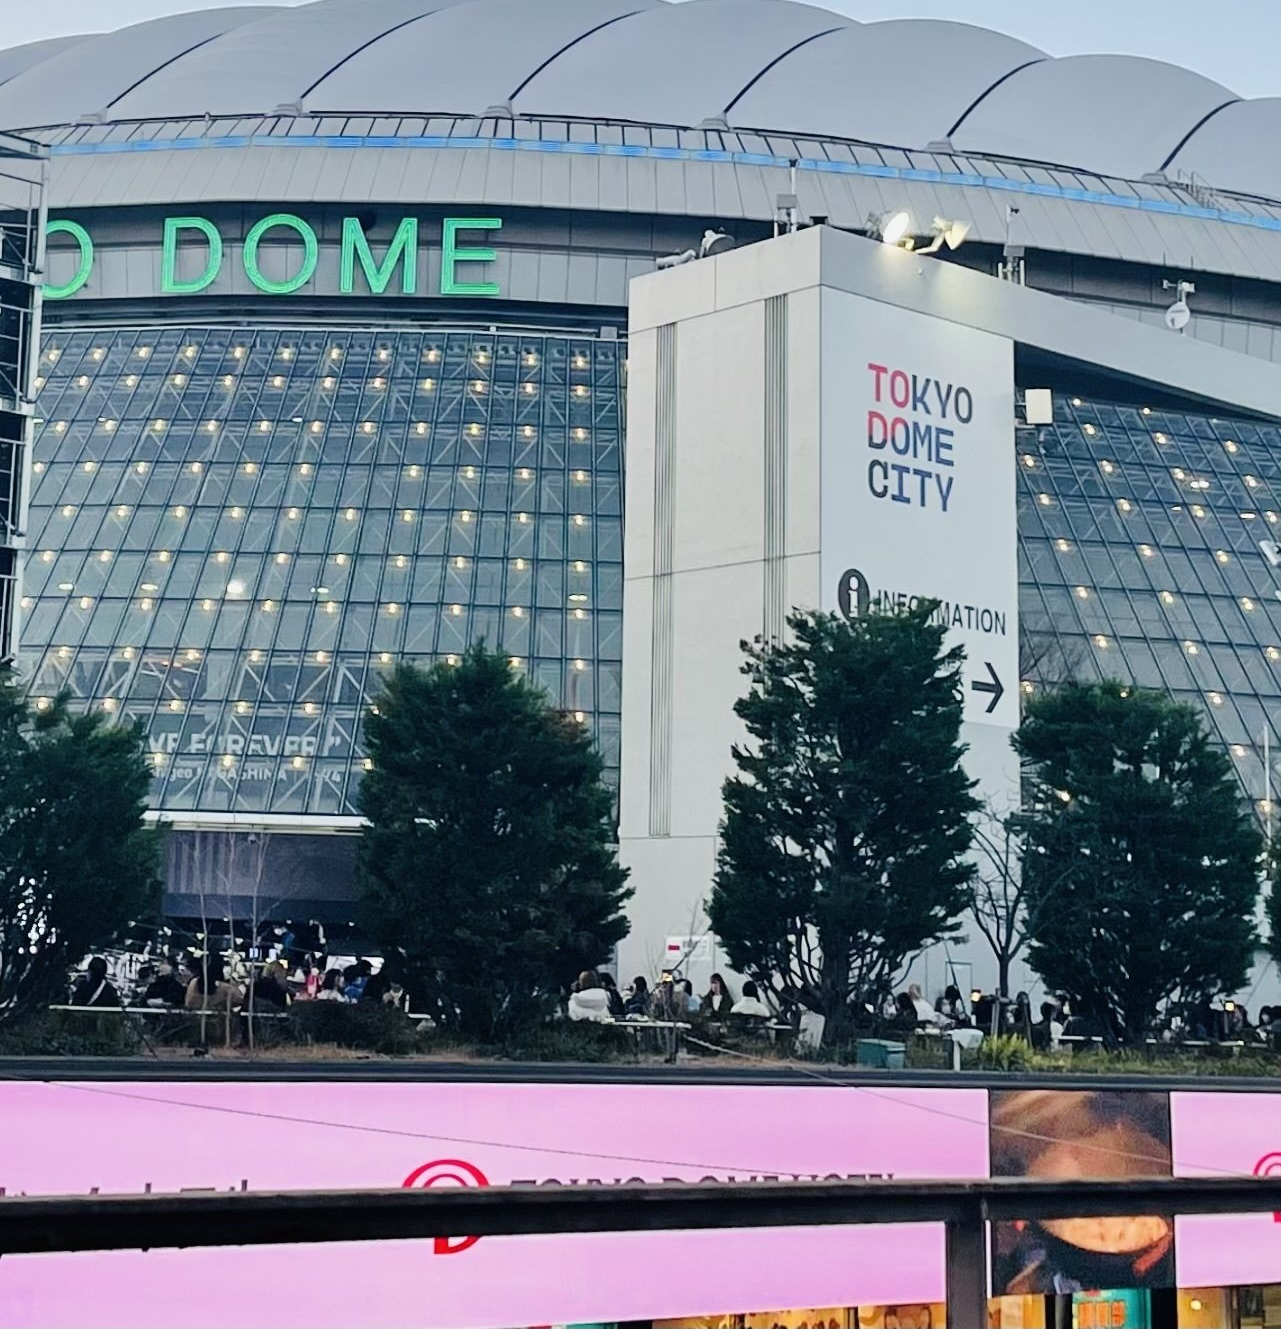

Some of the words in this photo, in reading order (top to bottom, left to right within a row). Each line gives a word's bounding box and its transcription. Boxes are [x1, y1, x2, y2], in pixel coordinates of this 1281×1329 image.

[161, 213, 502, 295] DOME
[868, 363, 973, 424] TOKYO
[868, 410, 954, 467] DOME
[868, 459, 954, 512] CITY
